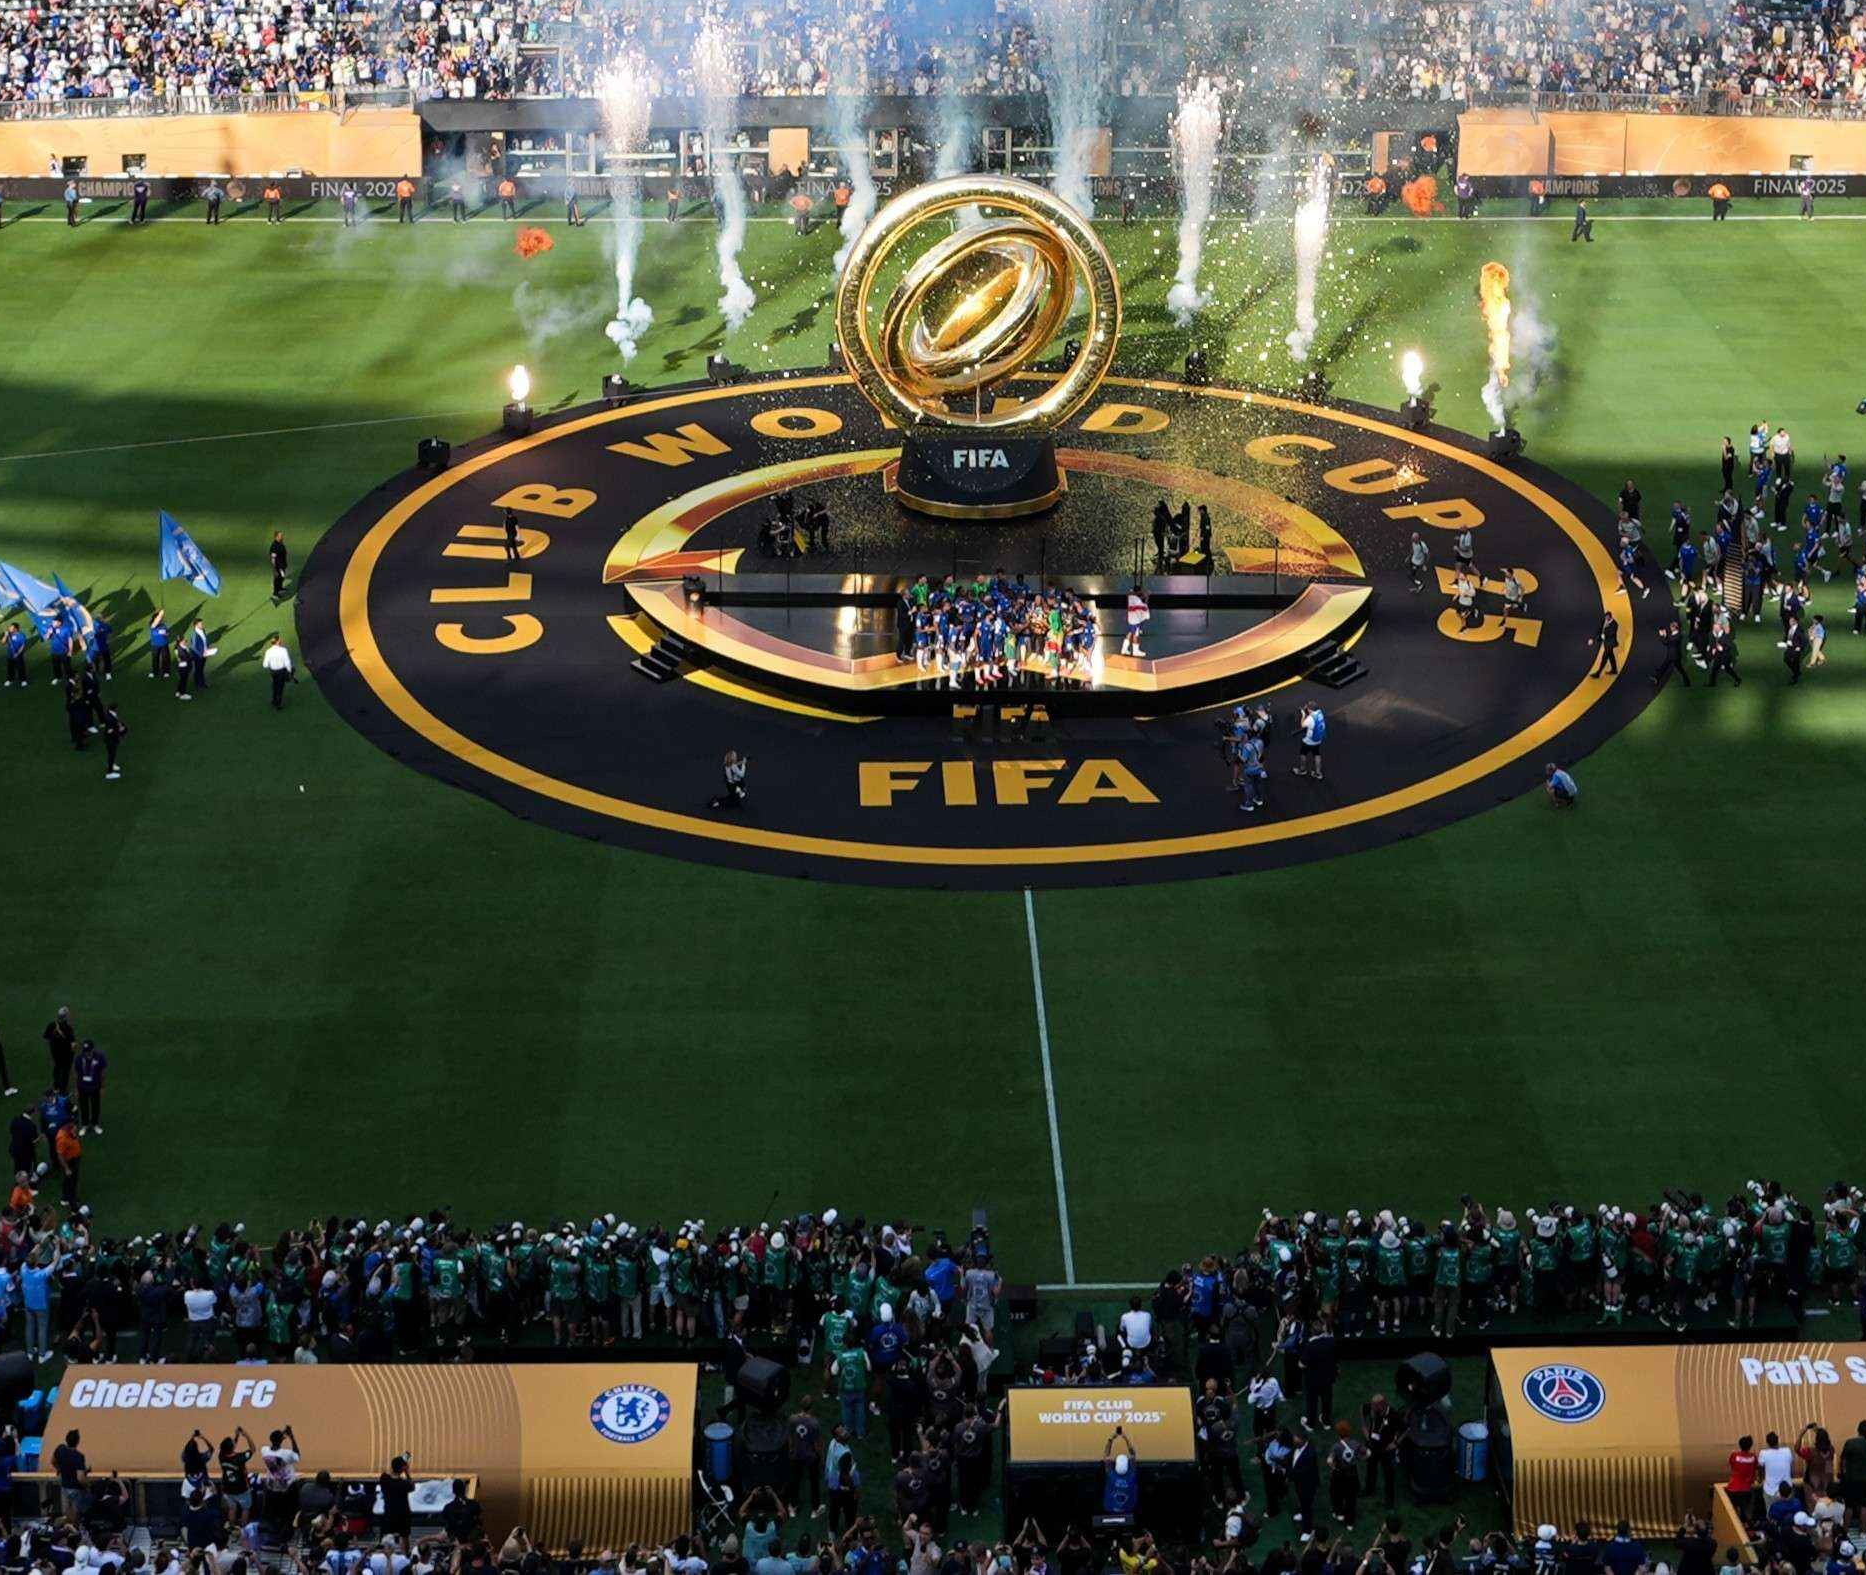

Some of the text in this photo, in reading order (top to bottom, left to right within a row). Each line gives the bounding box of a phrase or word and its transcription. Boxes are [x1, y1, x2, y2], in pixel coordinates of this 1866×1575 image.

[366, 181, 397, 197] 202
[952, 449, 1011, 469] FIFA
[429, 481, 596, 655] CLUB
[1243, 432, 1484, 535] CUP
[859, 759, 1161, 806] FIFA
[1533, 1365, 1583, 1381] PARIS
[1739, 1354, 1840, 1388] Paris
[69, 1378, 278, 1410] Chelsea FC
[603, 1383, 659, 1399] CHELSEA
[1063, 1399, 1134, 1410] FIFA CLUB
[1038, 1411, 1090, 1424] WORLD
[1094, 1411, 1122, 1424] CUP
